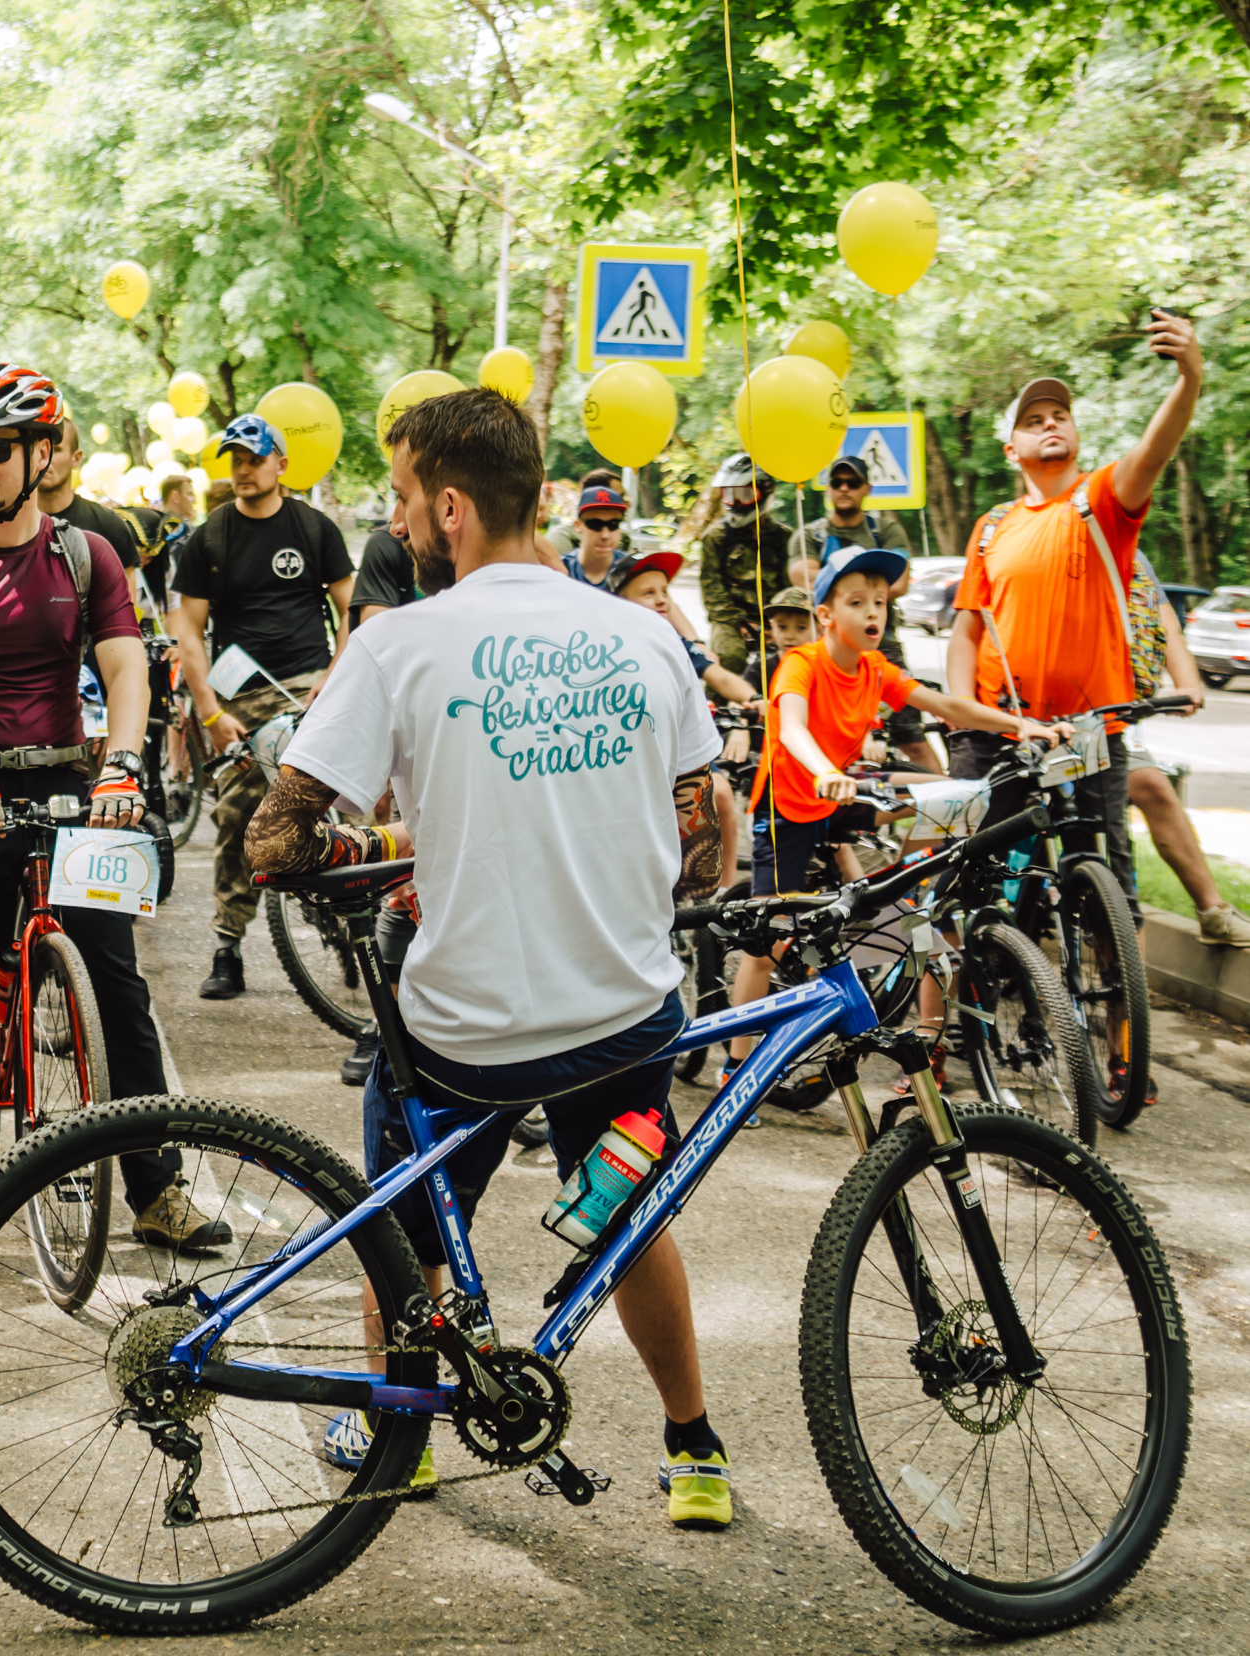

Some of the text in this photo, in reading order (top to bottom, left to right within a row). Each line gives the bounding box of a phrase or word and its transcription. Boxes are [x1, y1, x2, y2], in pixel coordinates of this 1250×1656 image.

[284, 421, 332, 438] Tinkoff.ru
[470, 630, 640, 689] Человек
[446, 682, 656, 735] велосипед
[490, 724, 633, 782] счастье
[86, 854, 128, 884] 168
[89, 890, 118, 901] Tinkoff.ru
[165, 1120, 358, 1207] SCHWALBE
[629, 1070, 761, 1243] ZASKAR
[1081, 1165, 1181, 1342] RACING RALPH
[76, 1587, 181, 1616] RALPH
